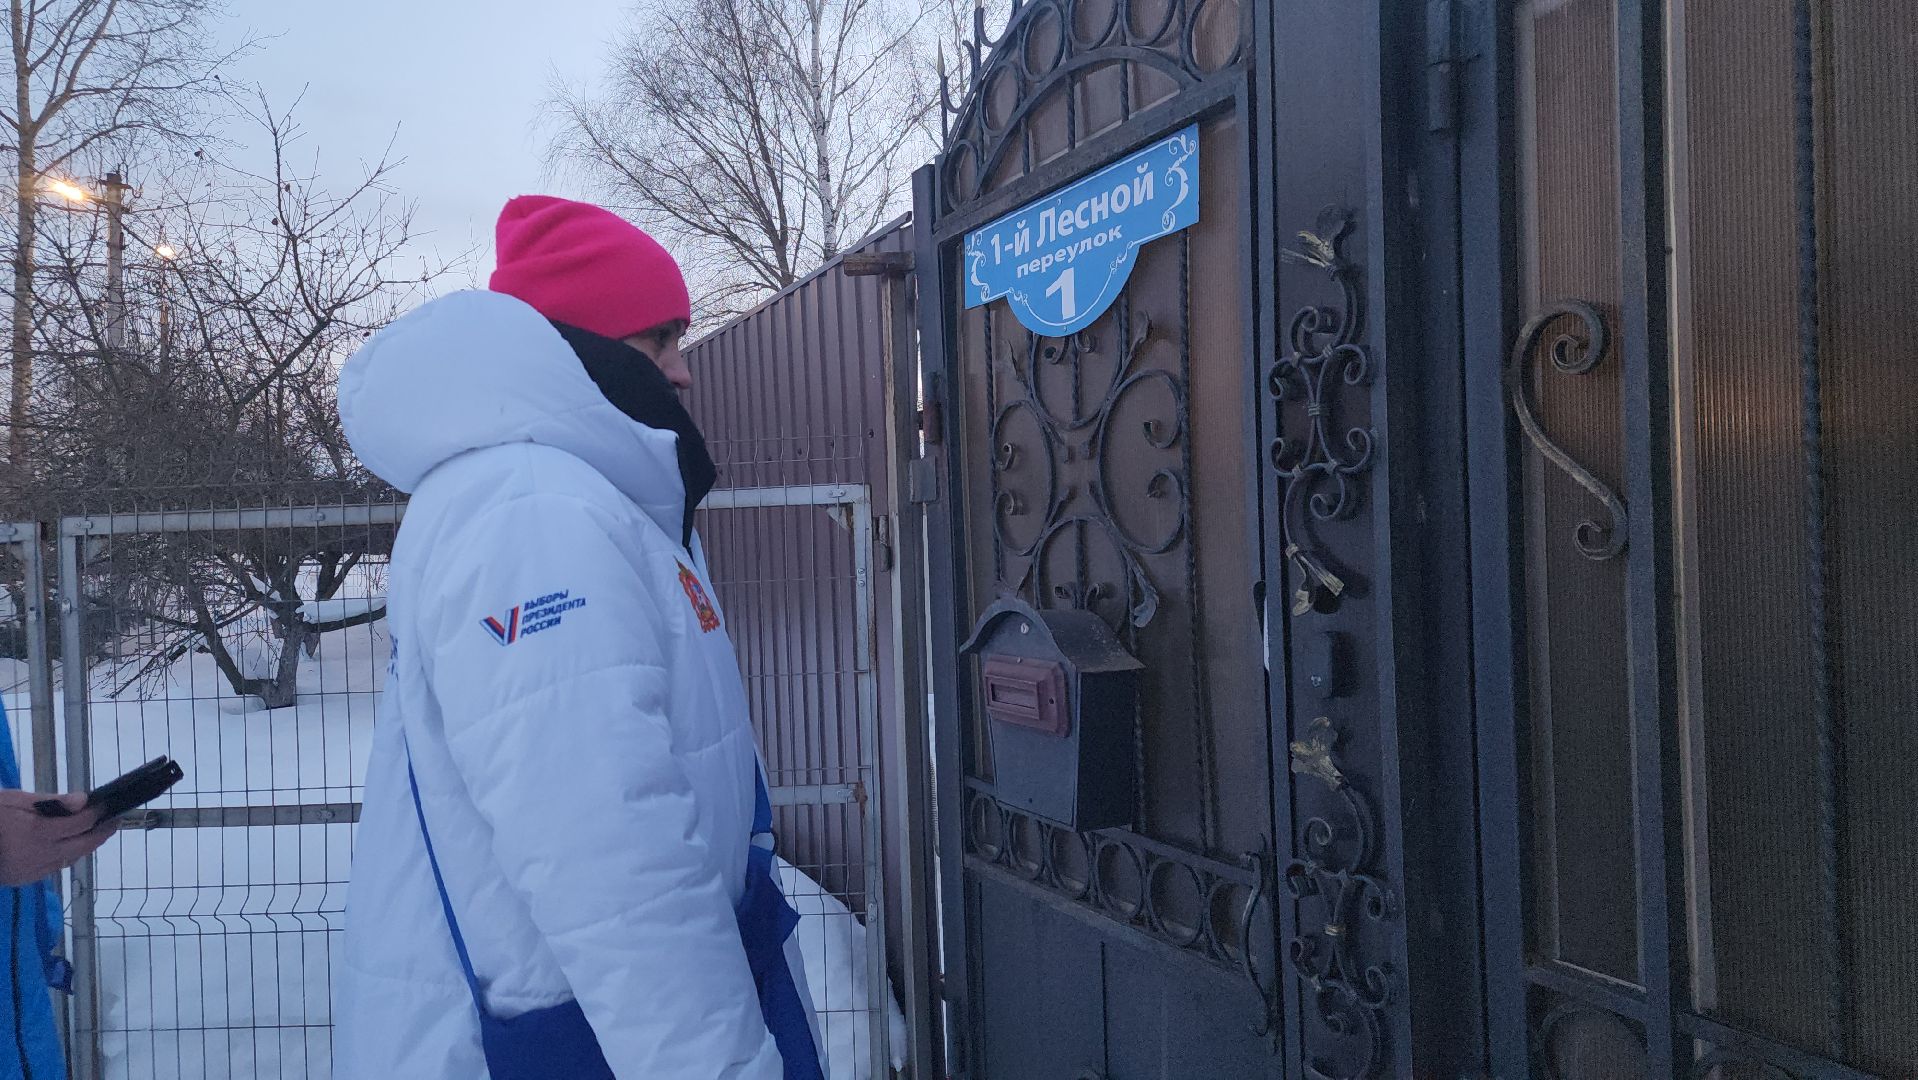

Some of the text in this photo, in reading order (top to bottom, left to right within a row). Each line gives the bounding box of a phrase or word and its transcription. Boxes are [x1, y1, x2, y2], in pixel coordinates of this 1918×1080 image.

[990, 162, 1154, 265] 1-й Лесной
[1017, 225, 1122, 278] переулок
[1045, 267, 1076, 320] 1
[522, 598, 586, 625] ПРЕЗИДЕНТА
[524, 589, 569, 611] ВЫБОРЫ
[520, 616, 562, 638] РОССИИ
